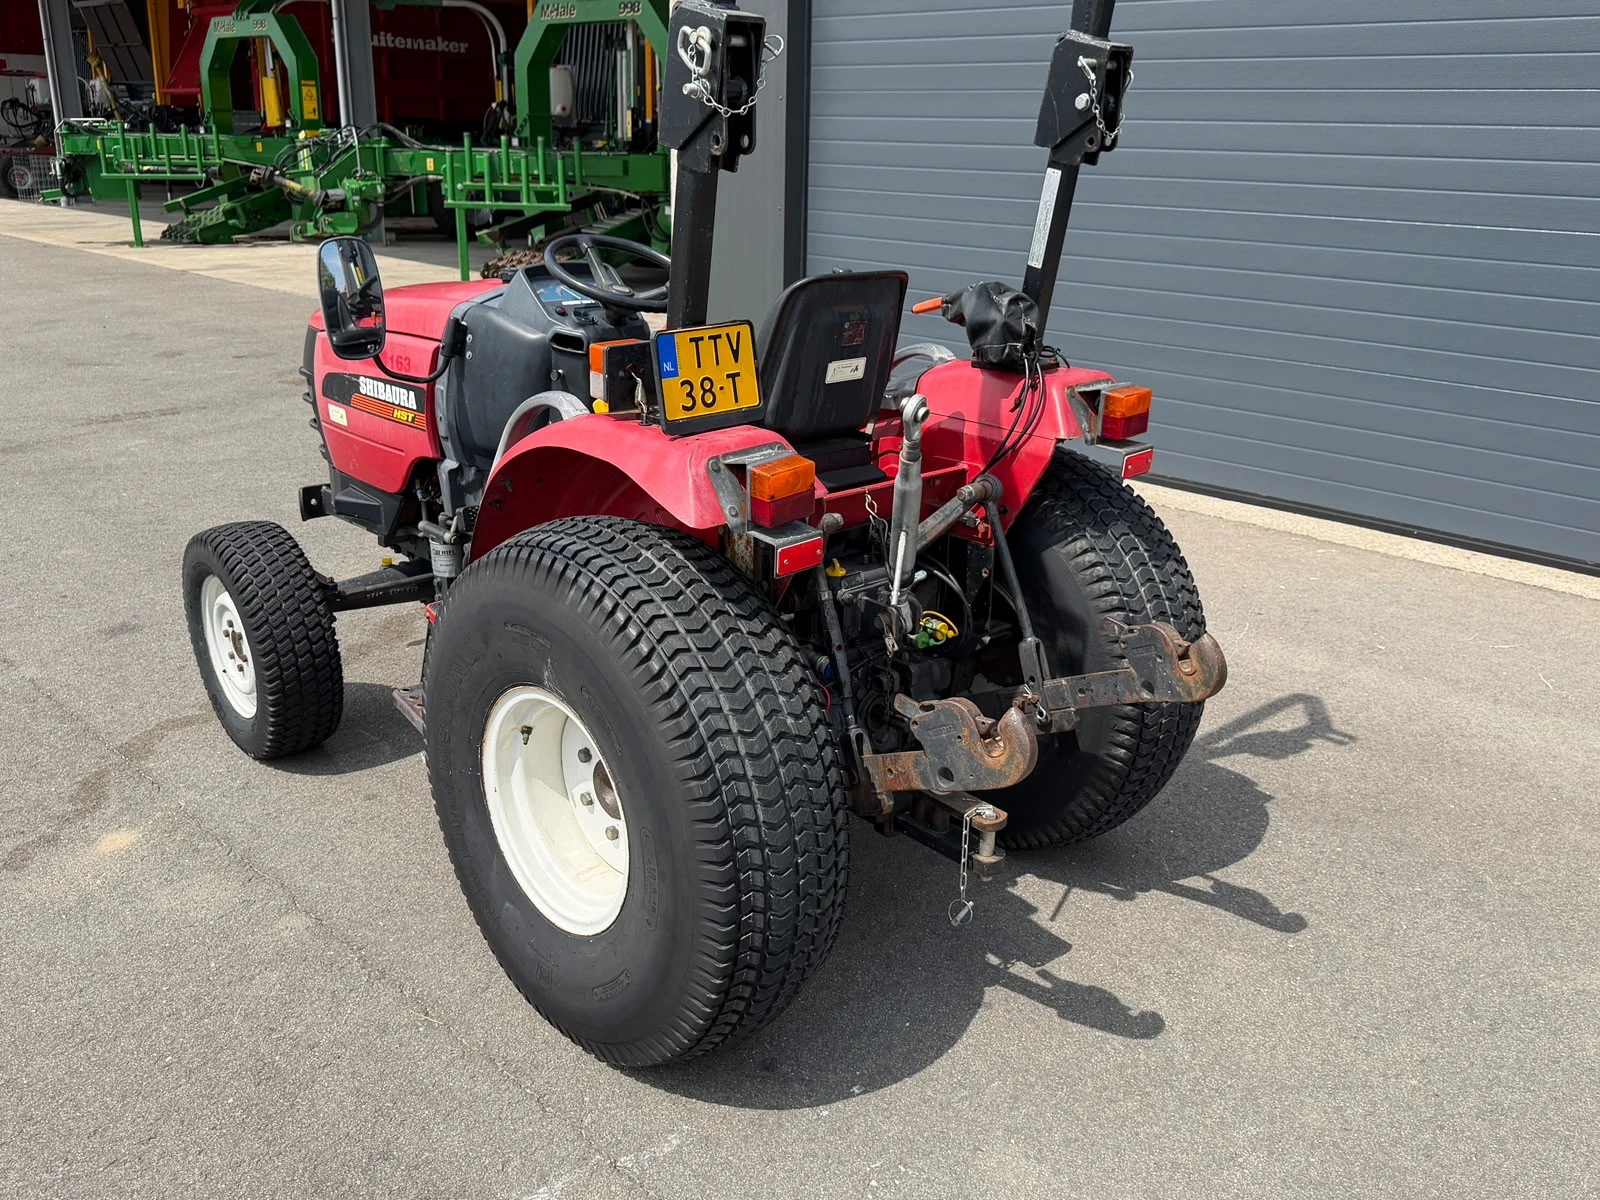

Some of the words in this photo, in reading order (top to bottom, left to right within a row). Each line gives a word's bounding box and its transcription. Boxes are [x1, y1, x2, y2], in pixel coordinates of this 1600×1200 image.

[541, 2, 577, 20] McHale
[618, 1, 642, 17] 998
[253, 19, 268, 31] 998
[371, 31, 469, 53] uitemaker
[688, 331, 741, 369] TTV
[389, 354, 411, 373] 163
[663, 361, 675, 372] NL
[359, 375, 417, 410] SHIBAURA
[393, 408, 415, 422] HST
